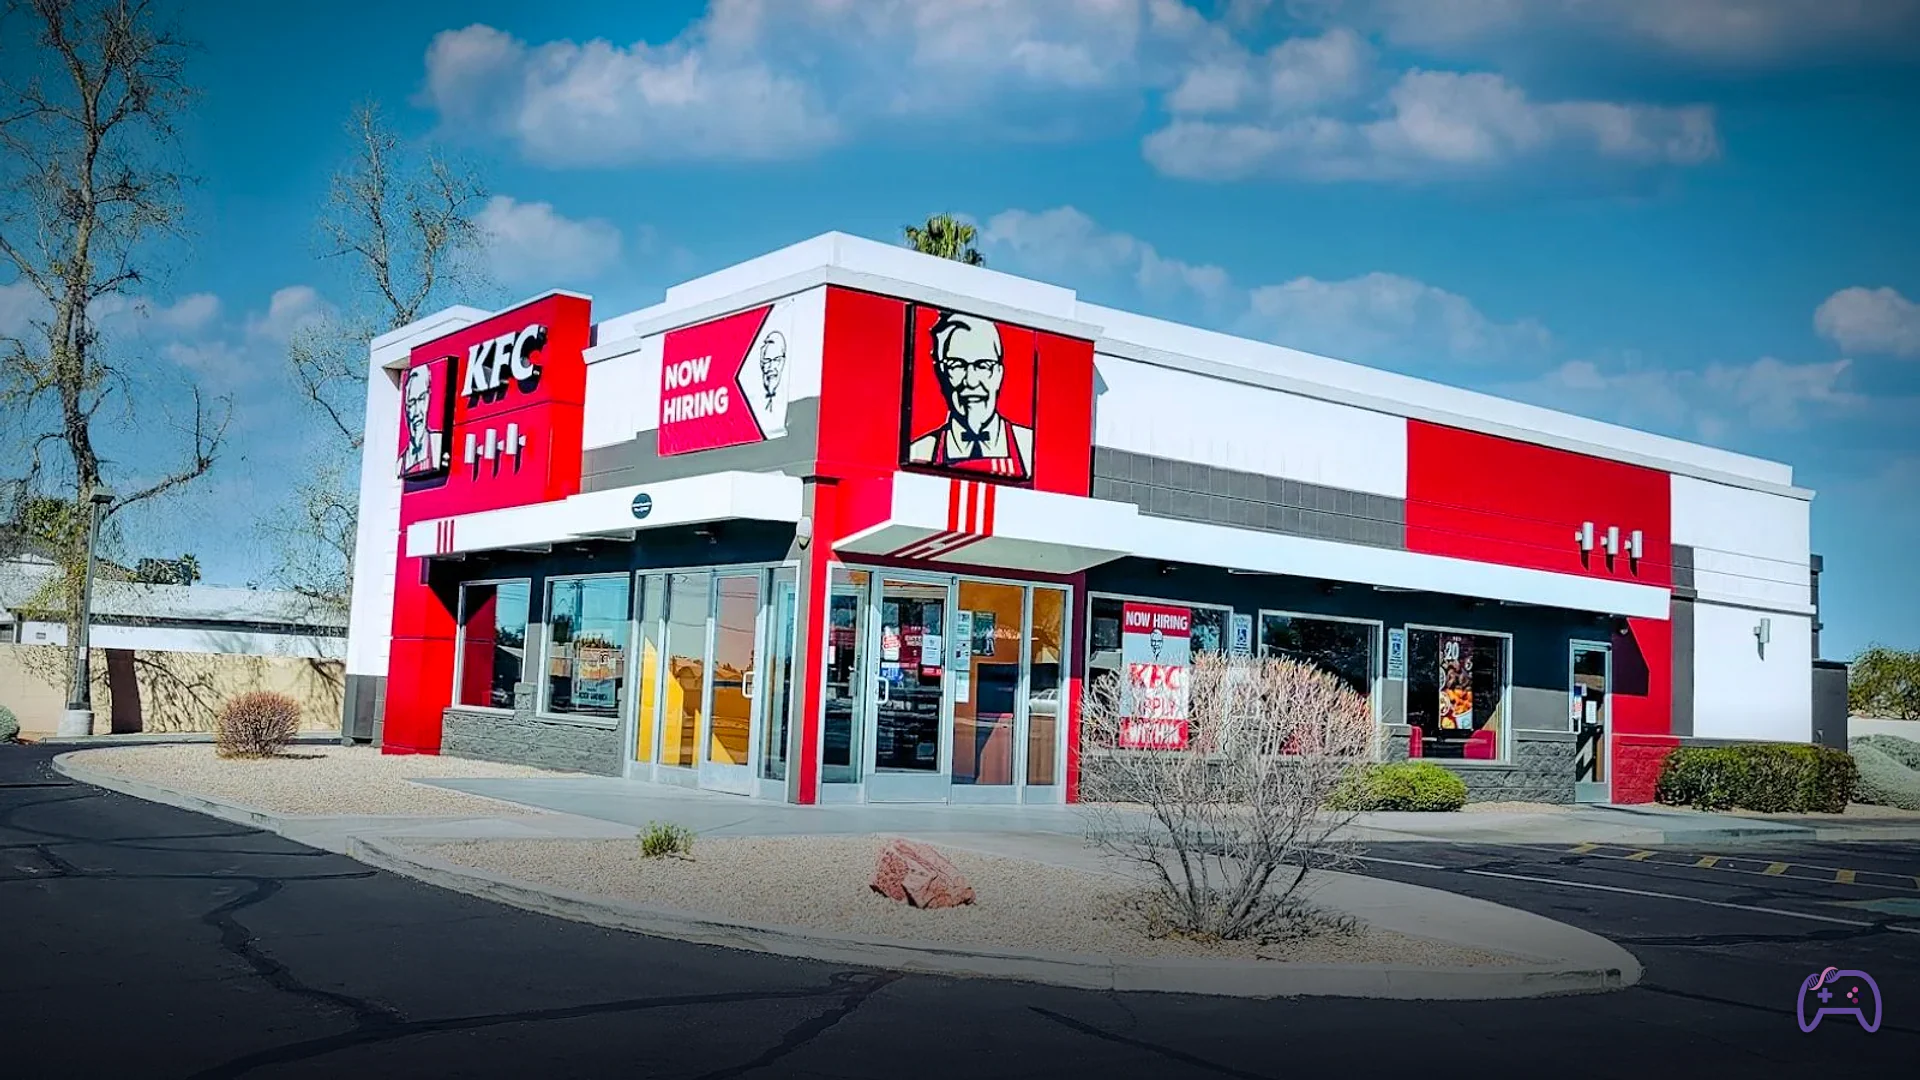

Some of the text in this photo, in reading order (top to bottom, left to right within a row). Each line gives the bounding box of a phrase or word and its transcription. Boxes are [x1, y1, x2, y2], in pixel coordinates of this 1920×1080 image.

[461, 323, 542, 397] KFC
[664, 355, 712, 391] NOW
[662, 386, 729, 425] HIRING
[1125, 610, 1189, 631] NOW HIRING
[1129, 663, 1183, 691] KFC
